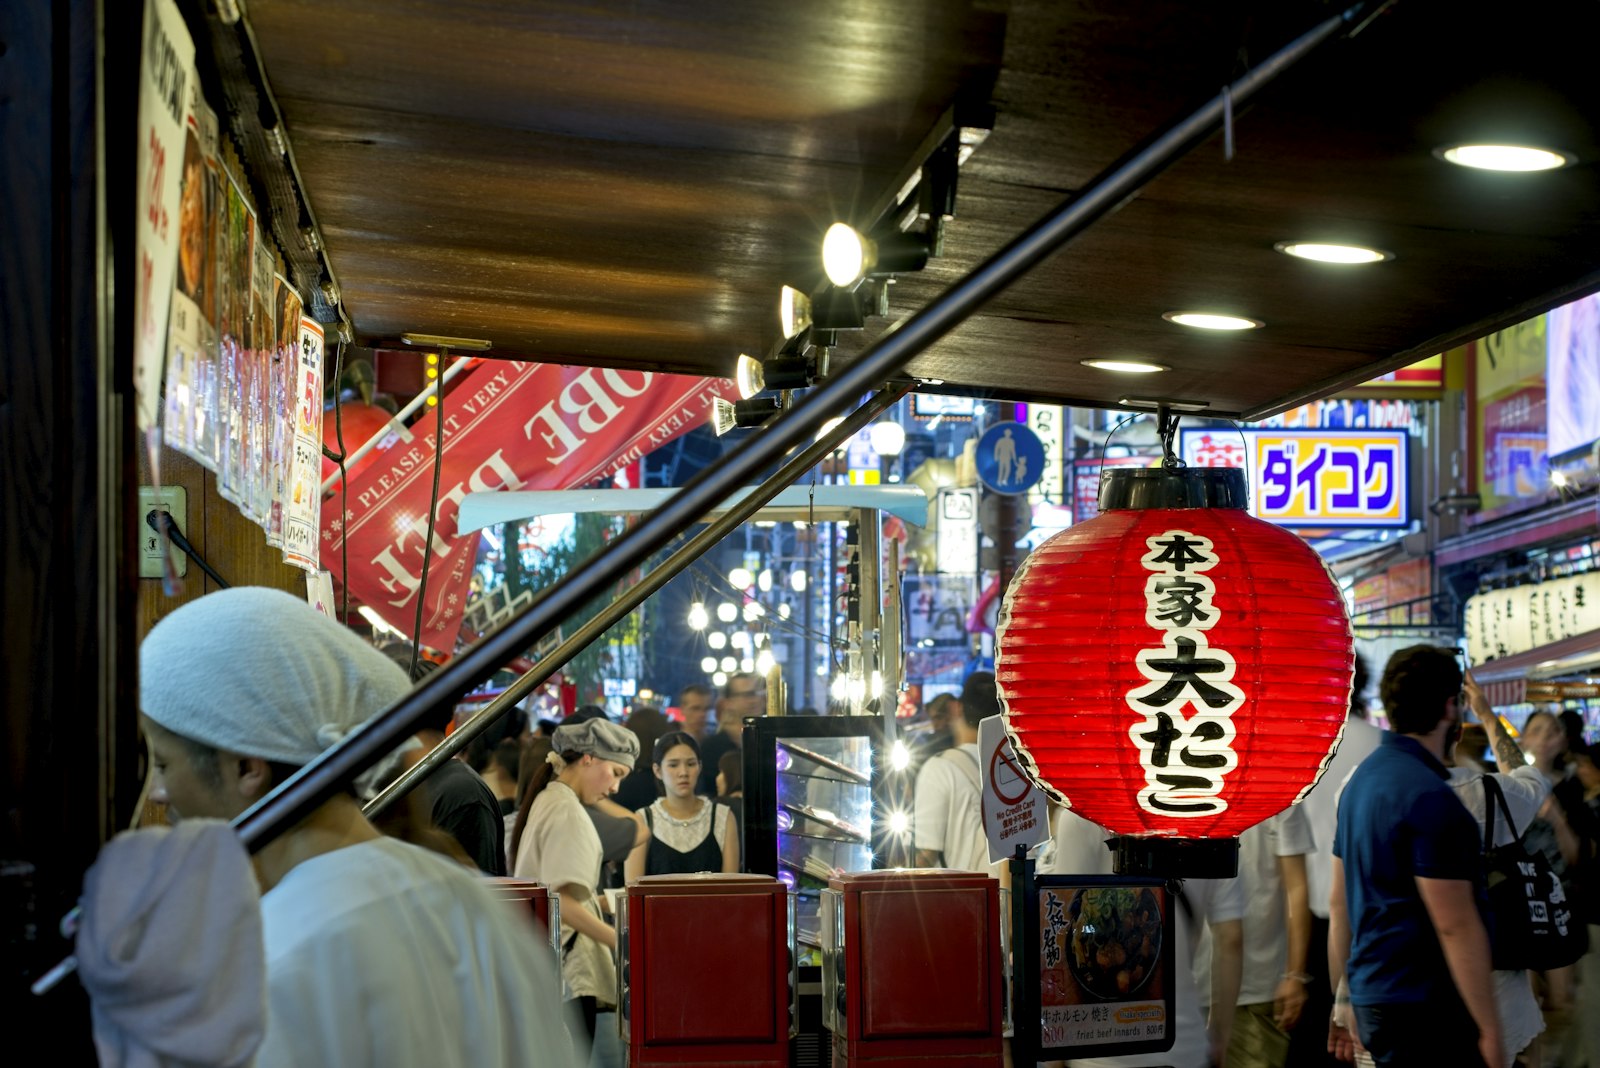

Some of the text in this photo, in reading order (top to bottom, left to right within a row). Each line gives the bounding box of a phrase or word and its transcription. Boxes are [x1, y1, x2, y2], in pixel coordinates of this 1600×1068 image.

[698, 378, 736, 409] EAT
[357, 447, 425, 508] PLEASE
[424, 414, 461, 450] EAT
[462, 370, 509, 415] VERY
[648, 407, 697, 449] VERY
[1262, 443, 1395, 512] ダイコク
[1136, 534, 1235, 812] 本家大たこ
[996, 797, 1036, 821] No Credit Card
[1076, 1029, 1094, 1040] fried
[1097, 1028, 1112, 1038] beef
[1114, 1026, 1141, 1037] innards
